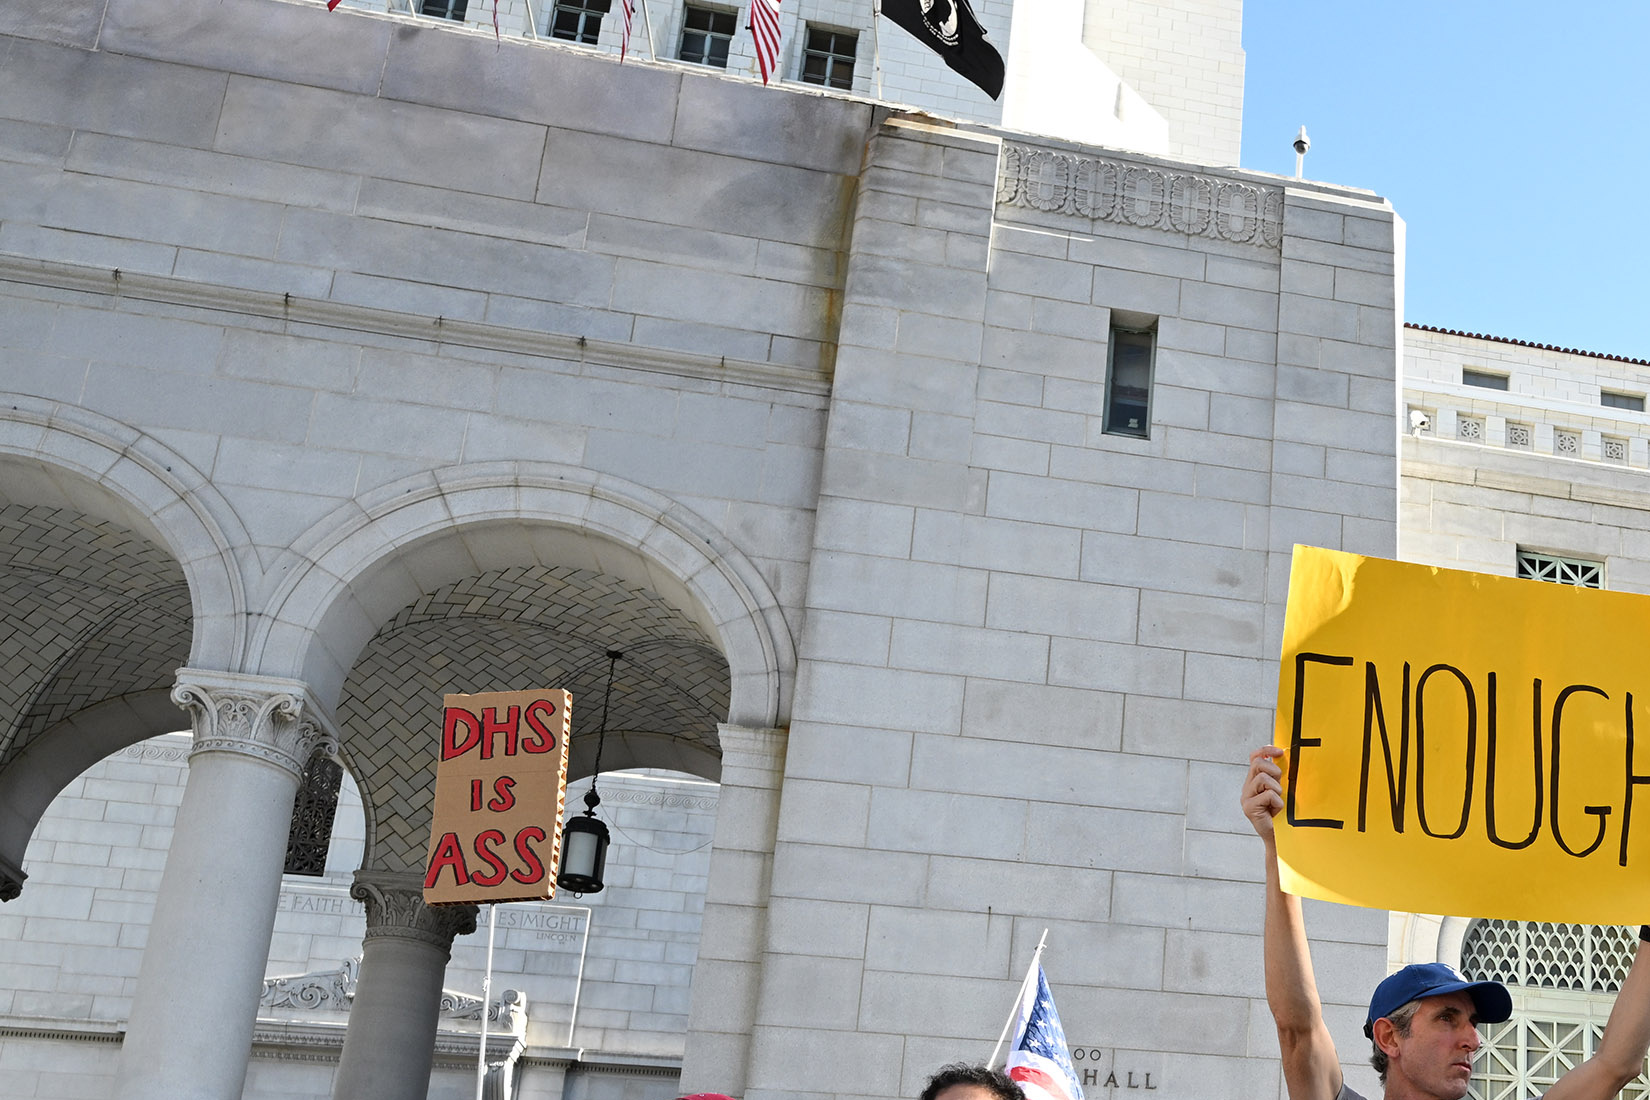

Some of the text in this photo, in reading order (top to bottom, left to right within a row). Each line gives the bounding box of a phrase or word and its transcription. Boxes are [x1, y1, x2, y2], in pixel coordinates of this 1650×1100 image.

[441, 699, 556, 761] DHS
[471, 776, 517, 812] IS
[423, 826, 547, 888] ASS
[293, 895, 344, 912] FAITH
[536, 932, 577, 942] LINCOLN
[1083, 1069, 1157, 1090] HALL
